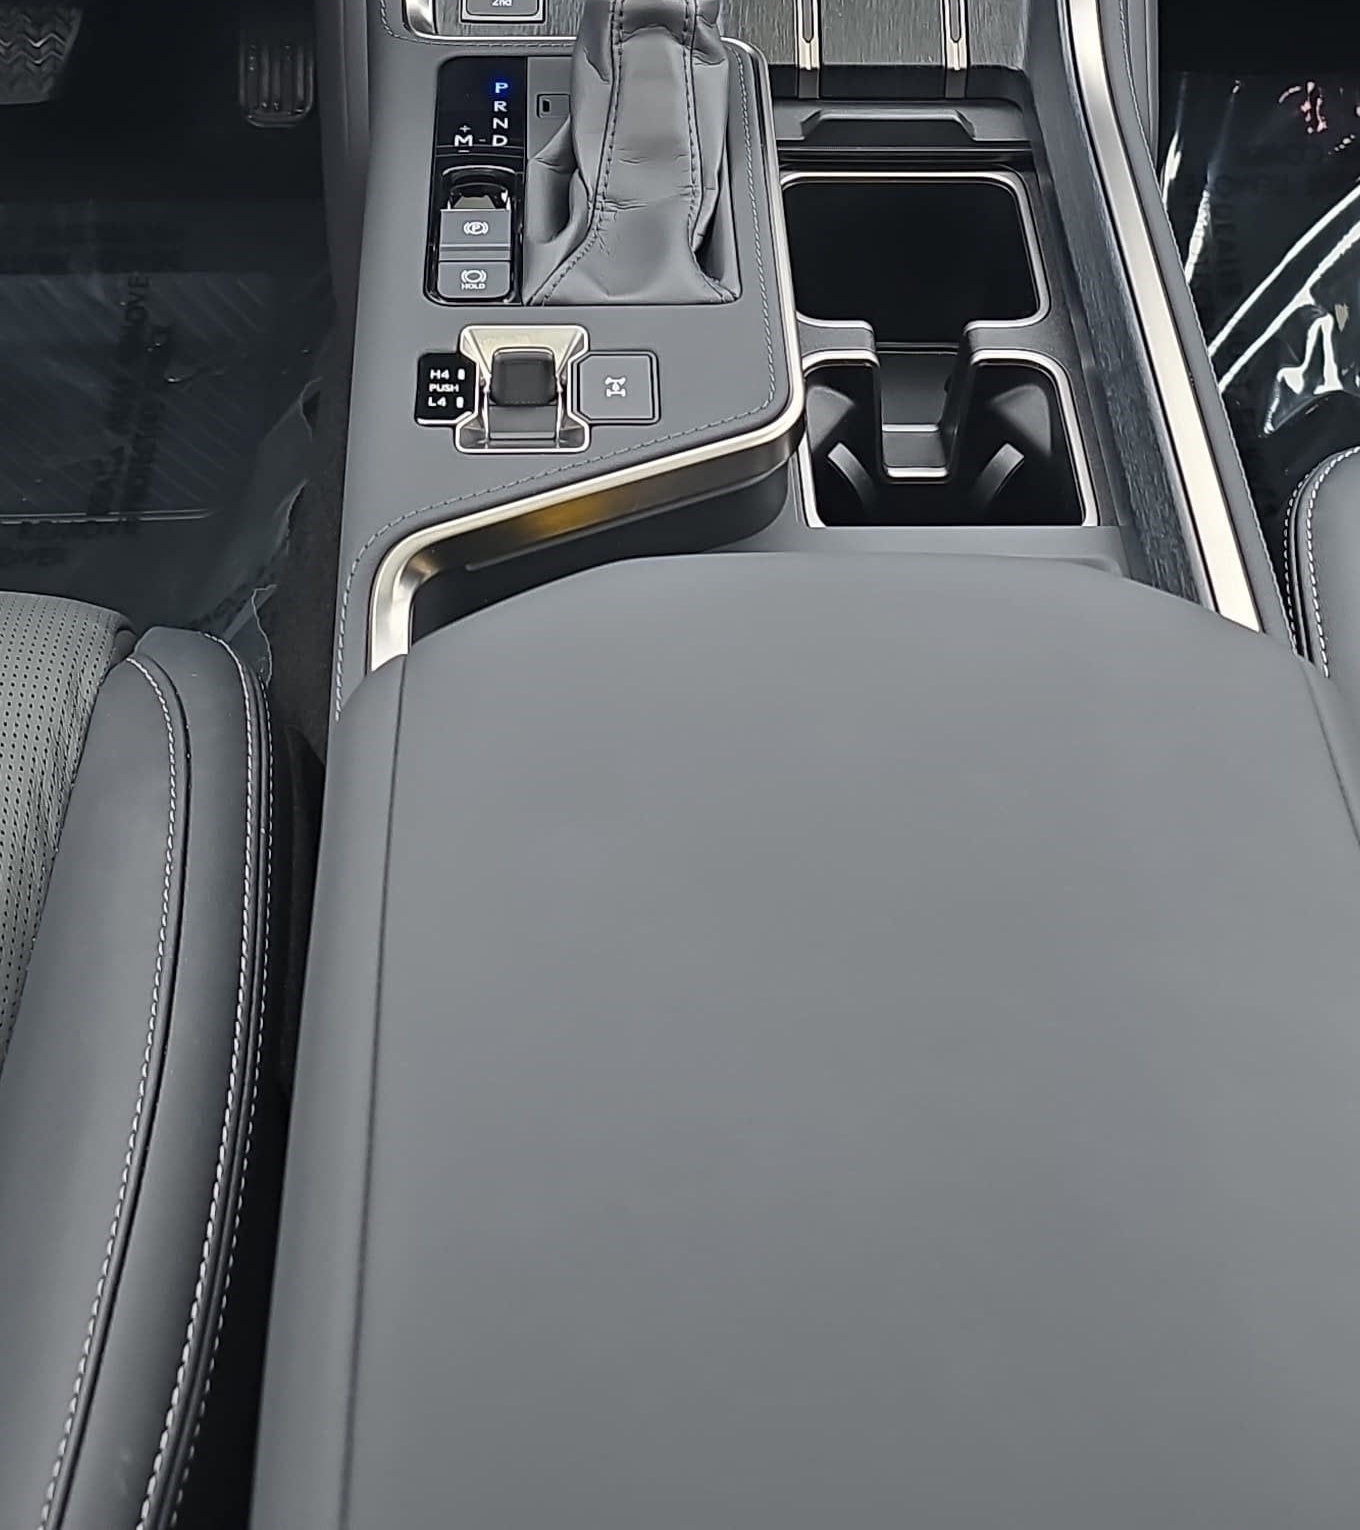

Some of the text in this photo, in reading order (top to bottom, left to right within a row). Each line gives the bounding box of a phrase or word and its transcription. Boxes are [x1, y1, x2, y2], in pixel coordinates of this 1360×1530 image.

[495, 82, 509, 94] P
[493, 100, 508, 112] R
[492, 117, 509, 130] N
[454, 134, 508, 147] M D
[461, 282, 486, 290] HOLD
[430, 368, 450, 380] H4
[428, 383, 459, 392] PUSH
[427, 396, 447, 407] L4
